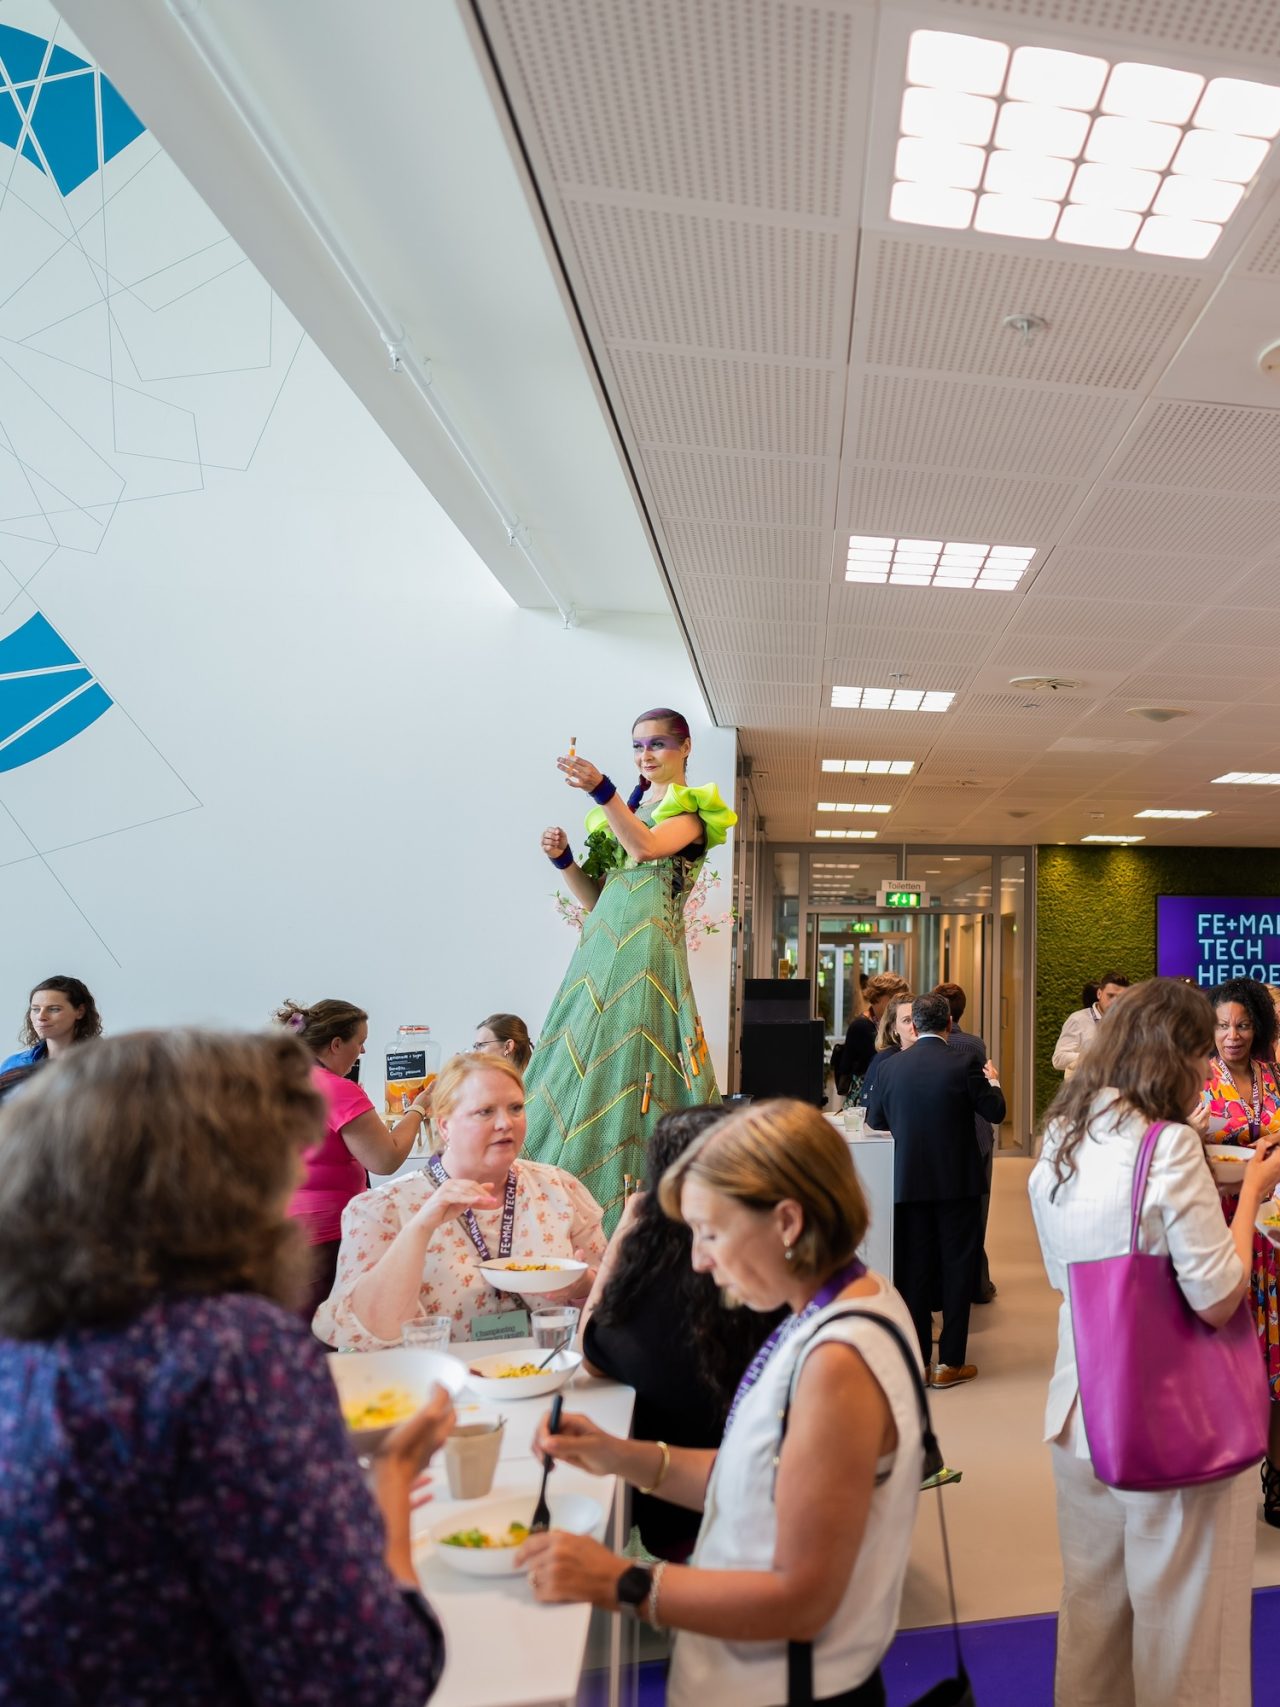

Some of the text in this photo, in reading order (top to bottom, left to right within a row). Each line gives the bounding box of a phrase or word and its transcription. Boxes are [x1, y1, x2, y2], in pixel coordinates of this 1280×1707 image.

[887, 881, 921, 890] Toiletten
[1198, 939, 1262, 960] TECH
[431, 1162, 448, 1183] ROES
[504, 1187, 515, 1210] TECH
[500, 1214, 513, 1254] FE+MALE
